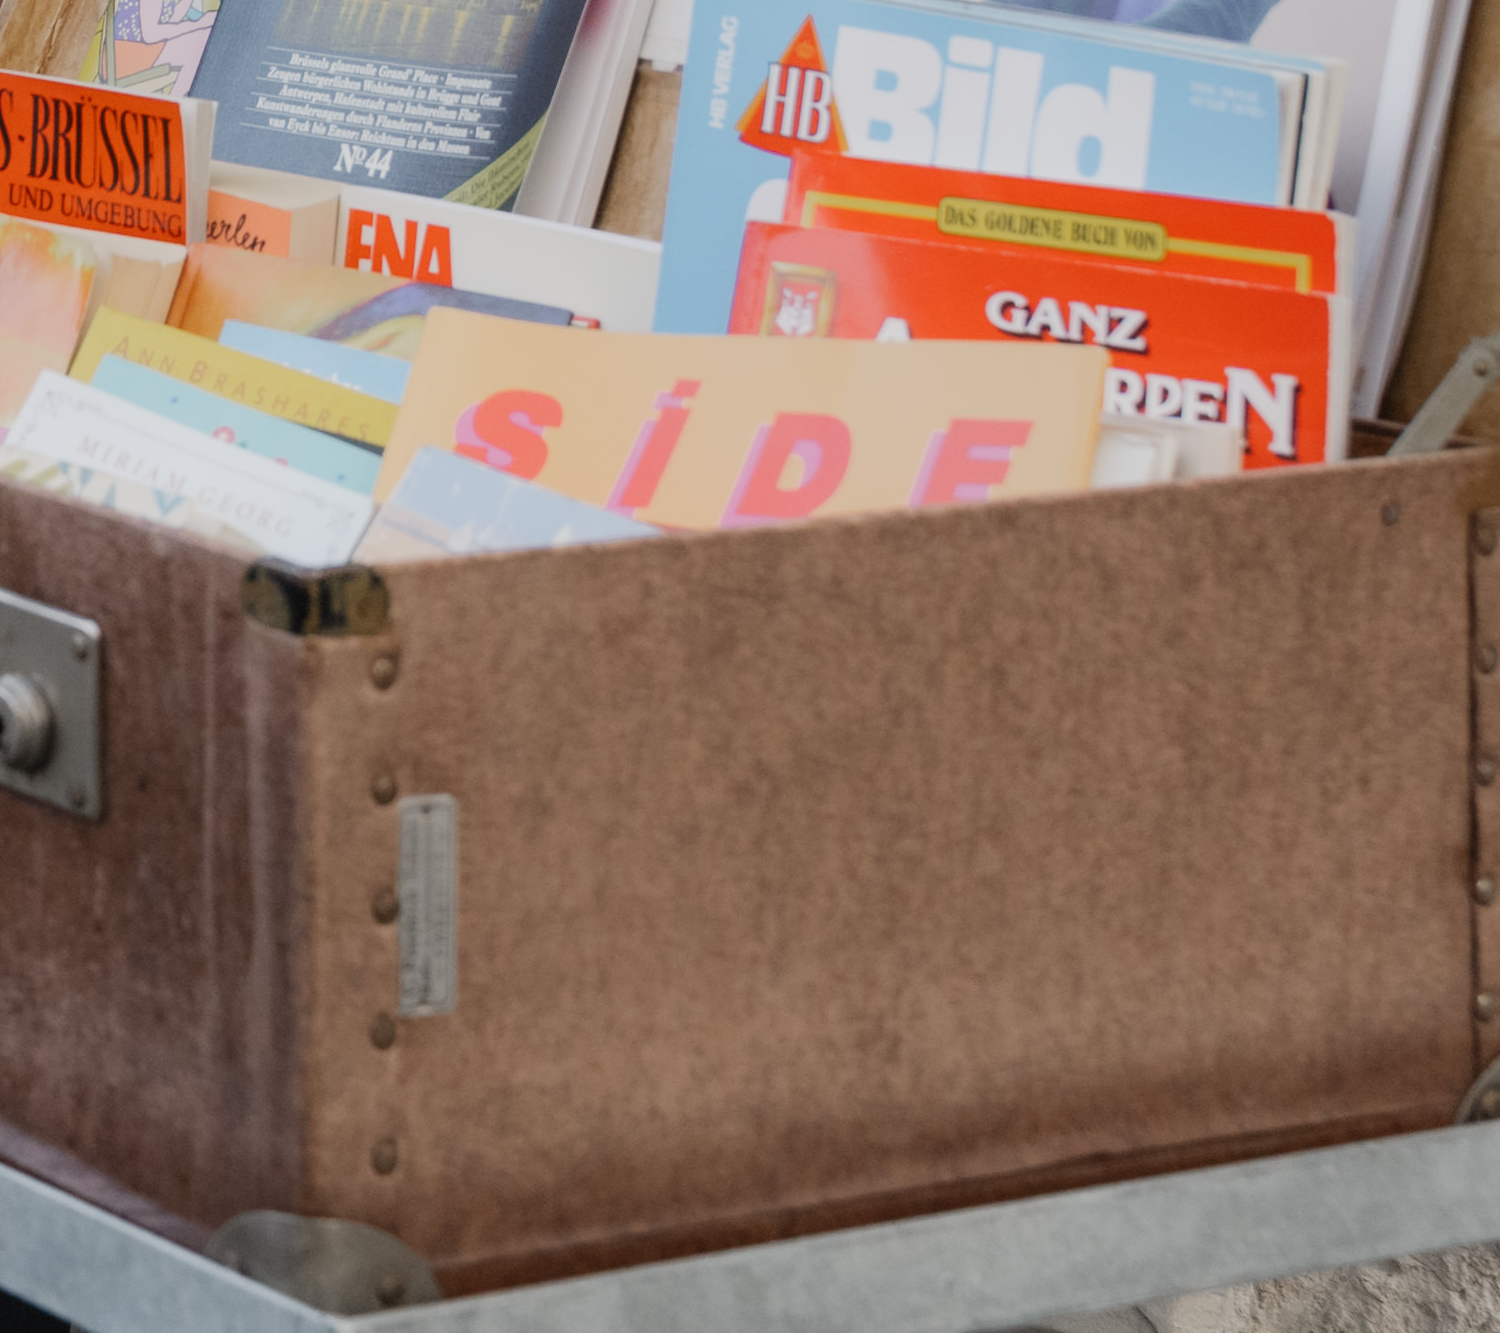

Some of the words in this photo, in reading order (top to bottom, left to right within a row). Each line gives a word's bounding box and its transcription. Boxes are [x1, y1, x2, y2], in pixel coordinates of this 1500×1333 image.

[713, 15, 739, 104] VERLAG
[760, 62, 833, 145] HB
[830, 25, 1156, 192] Bild
[29, 93, 183, 204] BRÜSSEL
[9, 182, 53, 212] UND
[61, 194, 182, 238] UMGEBUNG
[206, 214, 266, 253] erlen
[943, 203, 977, 227] DAS
[984, 207, 1063, 240] GOLDENE
[1070, 220, 1119, 247] BUCH
[1122, 227, 1157, 251] VON
[984, 290, 1149, 353] GANZ
[112, 335, 176, 374] ANN
[189, 359, 371, 441] BRASHARES
